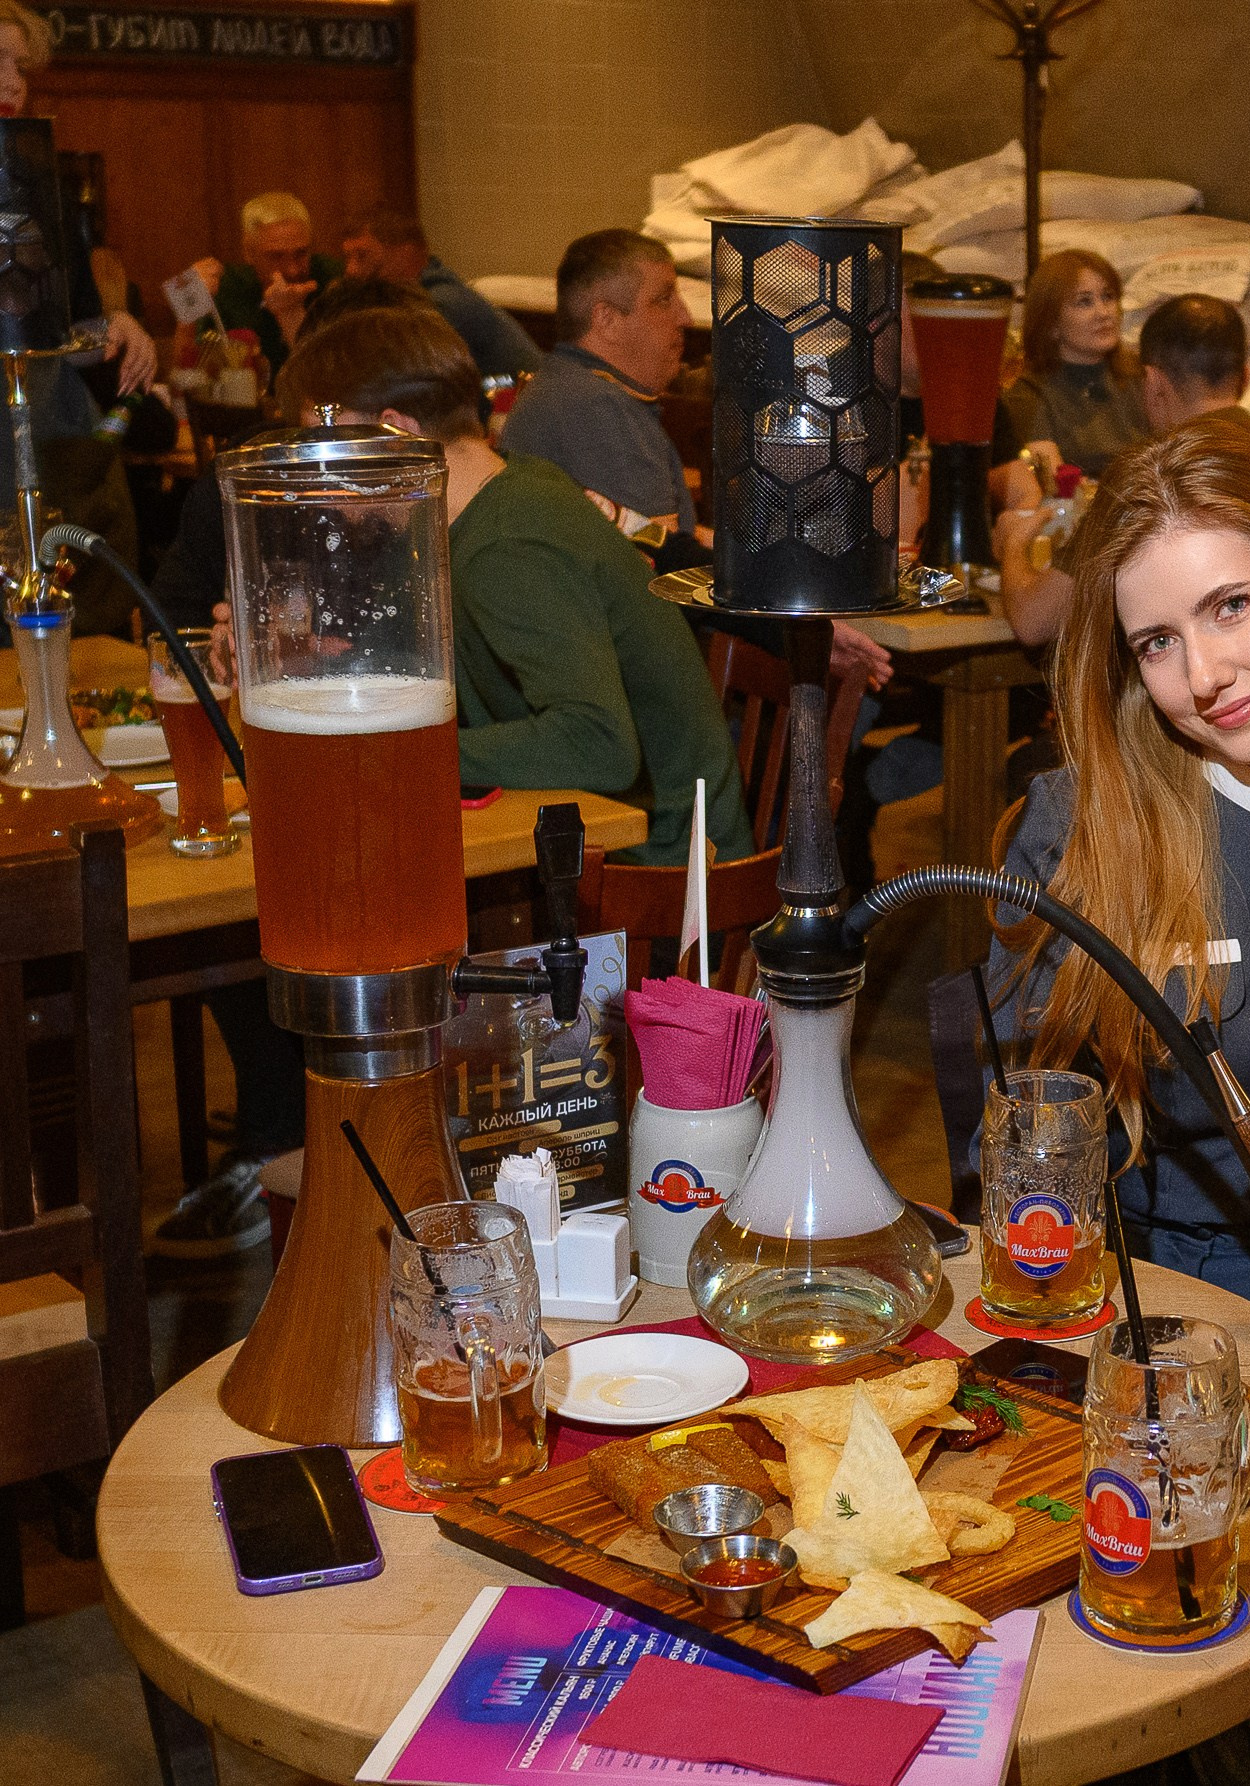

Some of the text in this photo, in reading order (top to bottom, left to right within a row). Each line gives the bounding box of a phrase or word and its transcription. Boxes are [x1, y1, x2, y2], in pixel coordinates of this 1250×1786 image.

[455, 1034, 616, 1117] 1+1=3
[478, 1101, 552, 1132] КАЖДЫЙ
[556, 1096, 598, 1117] ДЕНЬ
[550, 1139, 607, 1160] СУББОТА
[573, 1129, 601, 1141] шприц
[647, 1184, 665, 1197] Max
[577, 1627, 605, 1666] ФРУКТОВЫЕ
[597, 1640, 617, 1664] АНАНАС
[617, 1634, 639, 1665] АПЕЛЬСИН
[481, 1655, 548, 1706] MENU
[518, 1675, 580, 1768] КЛАССИЧЕСКИЙ КАЛЬЯН
[919, 1653, 1003, 1759] HOOKAH
